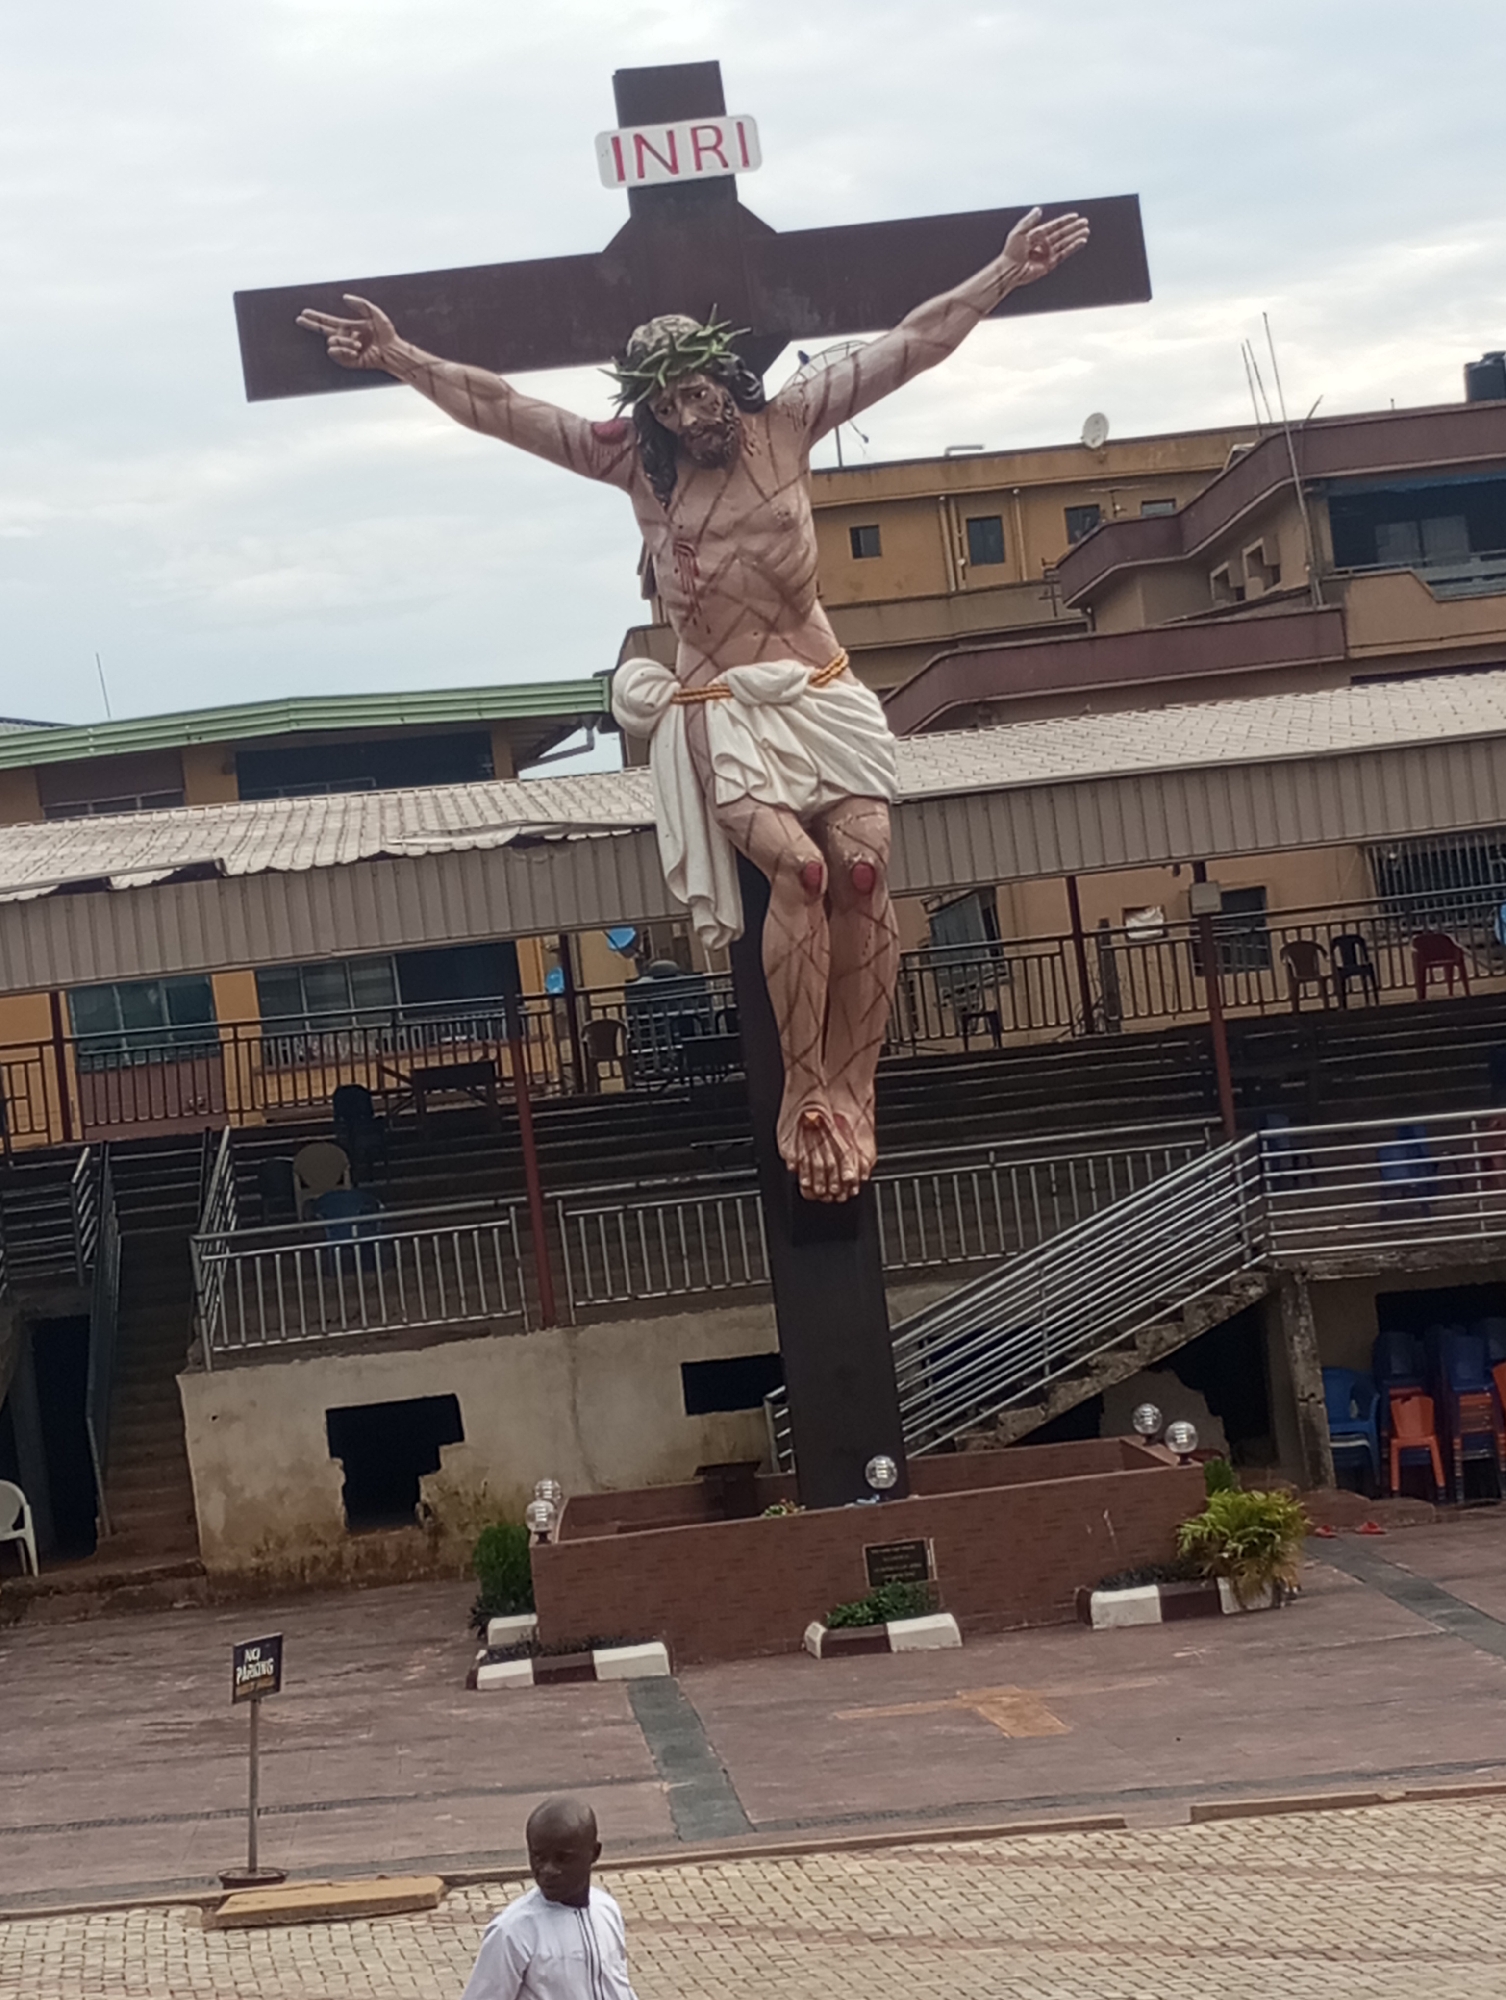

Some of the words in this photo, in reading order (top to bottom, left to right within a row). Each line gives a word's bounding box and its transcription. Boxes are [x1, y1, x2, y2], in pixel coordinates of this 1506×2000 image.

[611, 121, 750, 182] INRI
[245, 1647, 261, 1663] NO
[236, 1658, 274, 1685] PARKING
